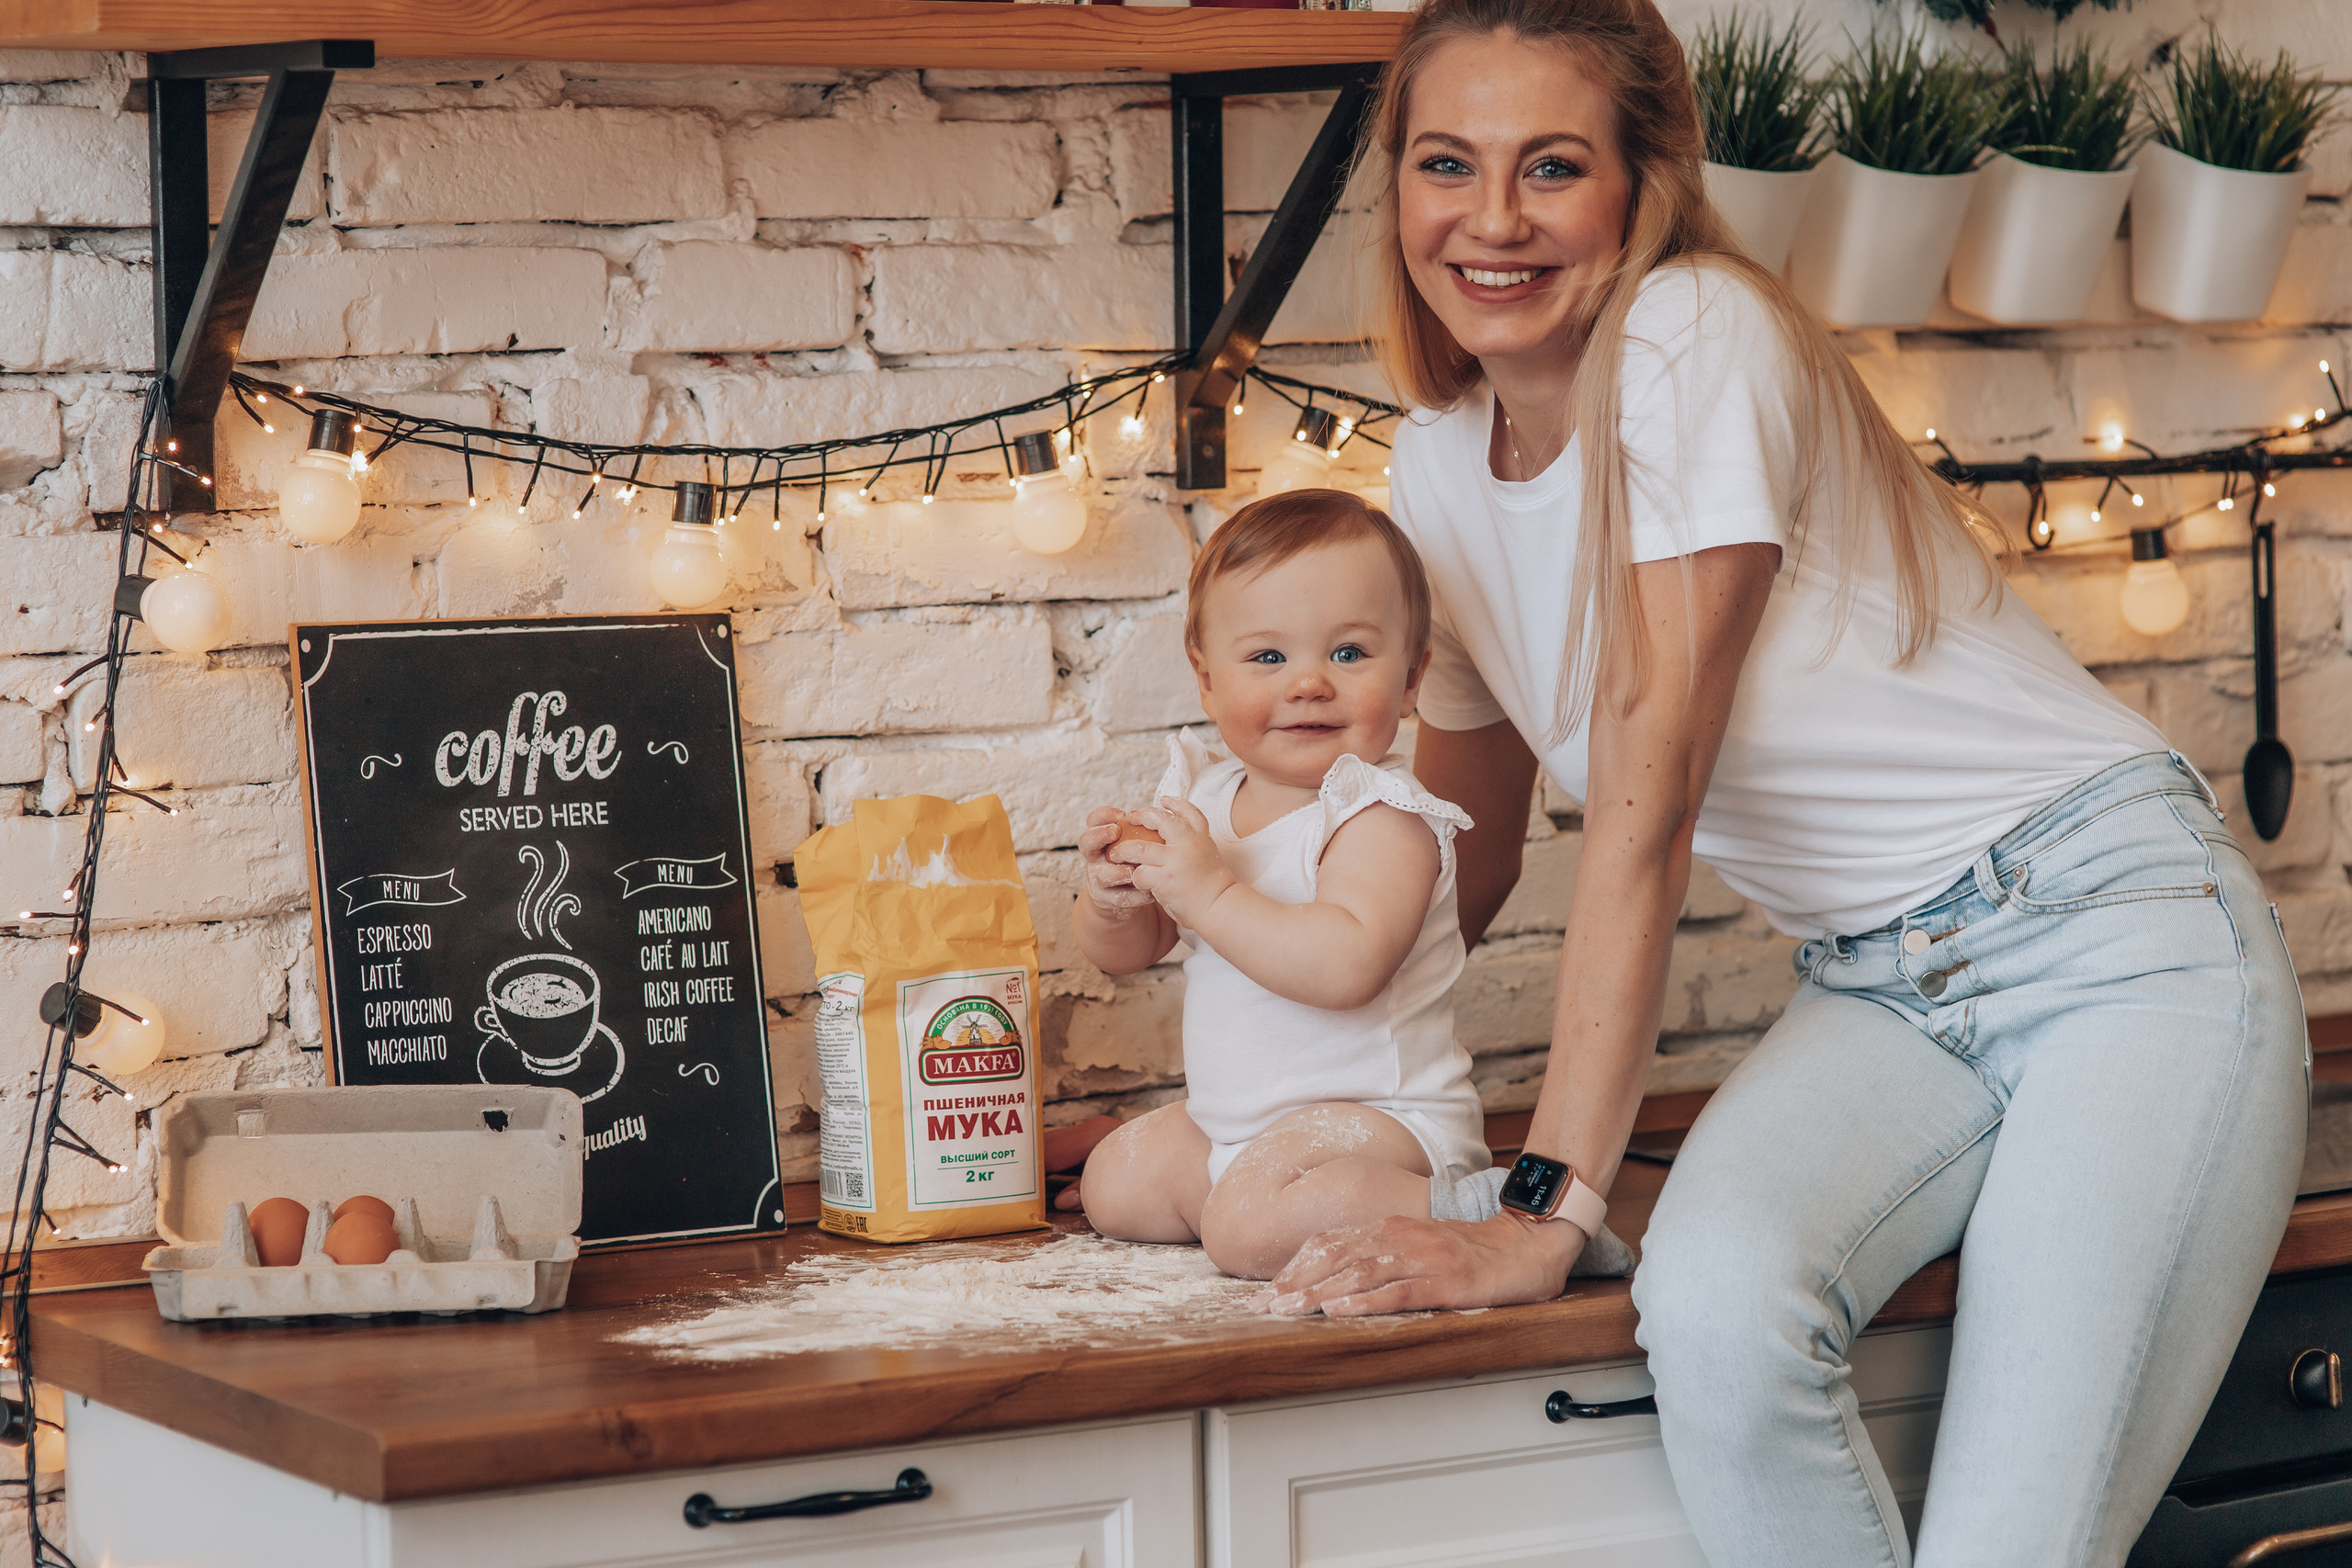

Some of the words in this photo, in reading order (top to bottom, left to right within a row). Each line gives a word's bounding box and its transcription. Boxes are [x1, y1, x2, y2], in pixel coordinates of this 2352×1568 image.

[435, 691, 622, 796] coffee
[460, 806, 543, 831] SERVED
[551, 802, 608, 827] HERE
[657, 863, 694, 885] MENU
[383, 880, 420, 901] MENU
[639, 906, 711, 934] AMERICANO
[357, 924, 431, 953] ESPRESSO
[641, 939, 673, 971] CAFÉ
[682, 943, 695, 968] AU
[702, 941, 729, 967] LAIT
[361, 957, 402, 991] LATTÉ
[645, 981, 679, 1008] IRISH
[686, 977, 734, 1004] COFFEE
[835, 1000, 842, 1011] 2
[366, 998, 451, 1028] CAPPUCCINO
[936, 1003, 970, 1031] ОСНОВАНА
[994, 1009, 1008, 1026] ГОДУ
[648, 1017, 688, 1044] DECAF
[368, 1035, 447, 1066] MACCHIATO
[933, 1055, 1015, 1075] MAKFA
[923, 1092, 1025, 1111] ПШЕНИЧНАЯ
[583, 1111, 647, 1160] quality
[927, 1109, 1023, 1141] МУКА
[940, 1151, 989, 1164] ВЫСШИЙ
[991, 1149, 1015, 1159] СОРТ
[966, 1169, 976, 1182] 2
[1531, 1185, 1547, 1207] 11:45
